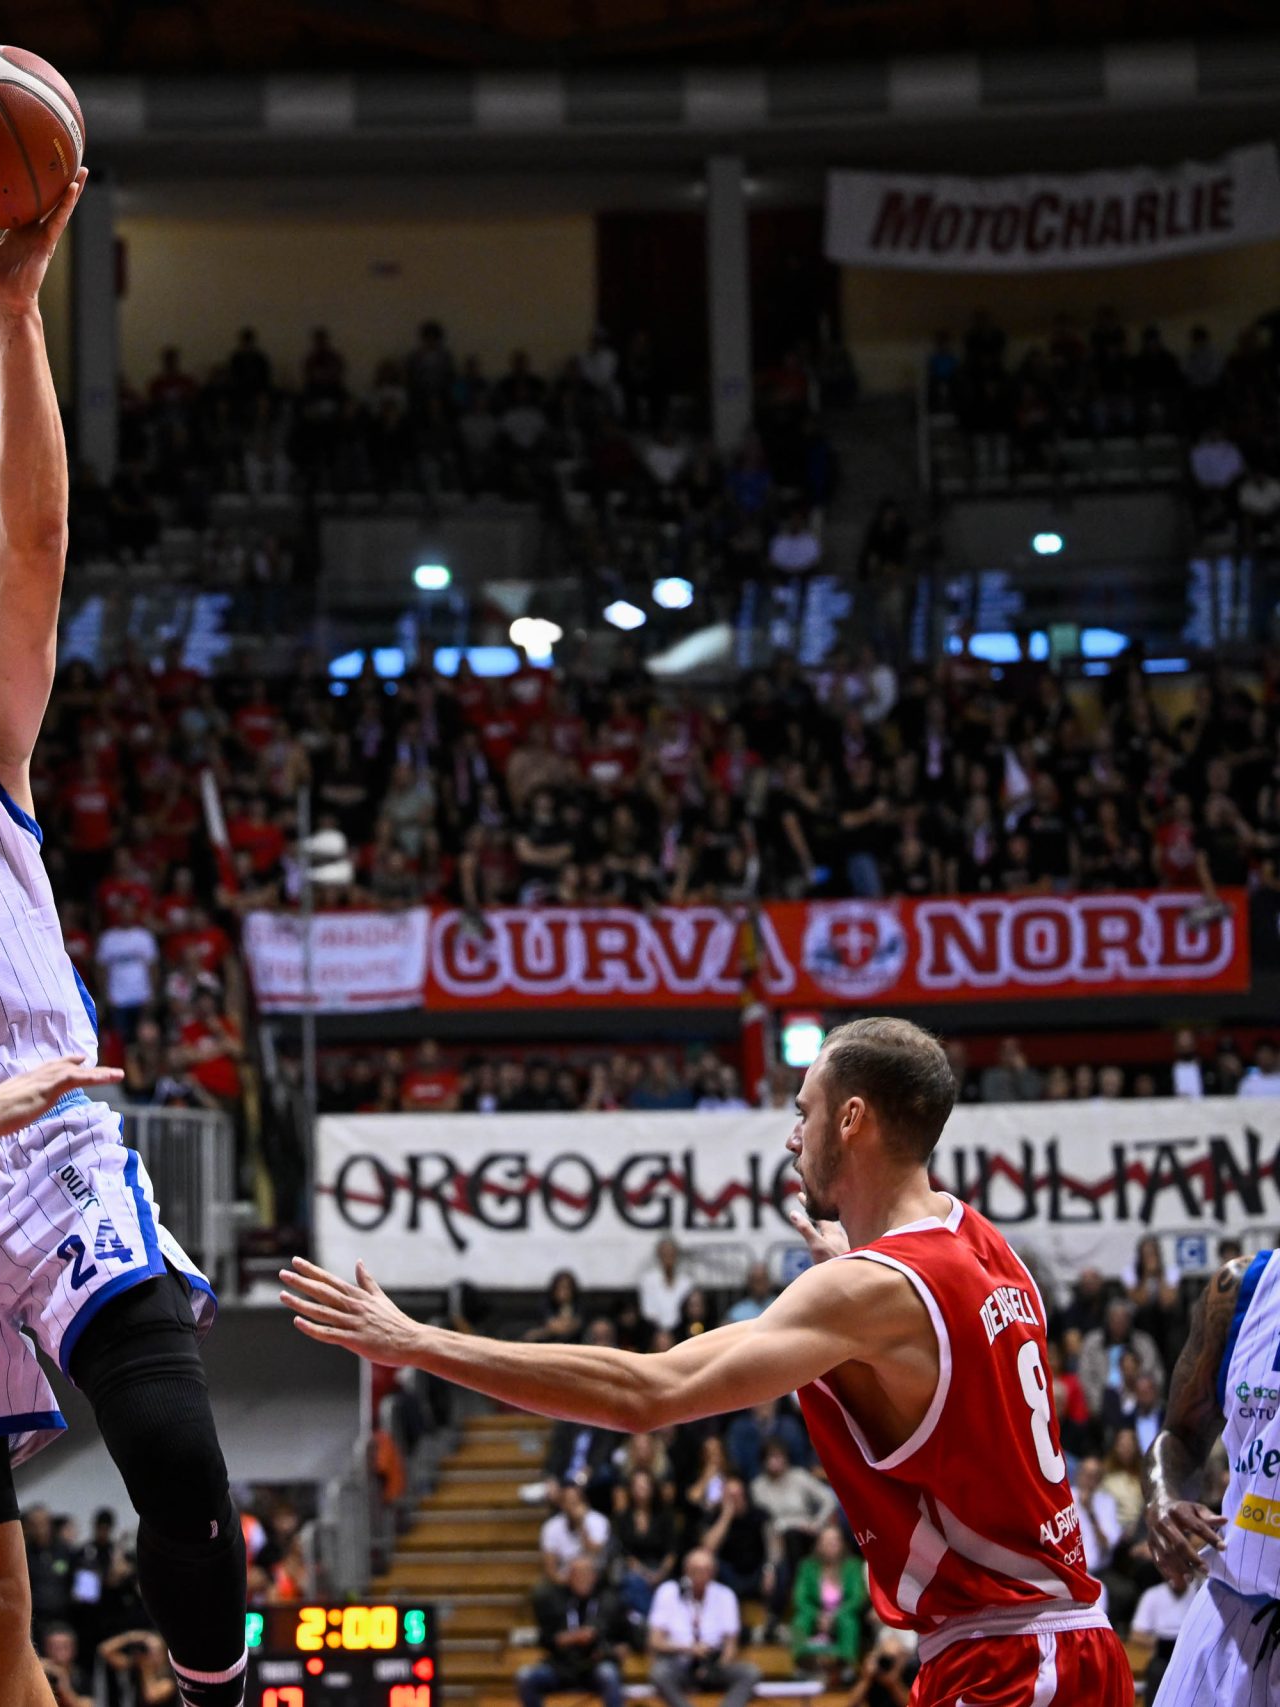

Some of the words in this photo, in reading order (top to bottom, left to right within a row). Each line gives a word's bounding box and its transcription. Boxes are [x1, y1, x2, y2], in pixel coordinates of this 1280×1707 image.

[436, 910, 791, 992] CURVA
[921, 897, 1231, 986] NORD
[57, 1219, 134, 1290] 24
[1017, 1339, 1066, 1484] 8
[296, 1606, 398, 1650] 2:00
